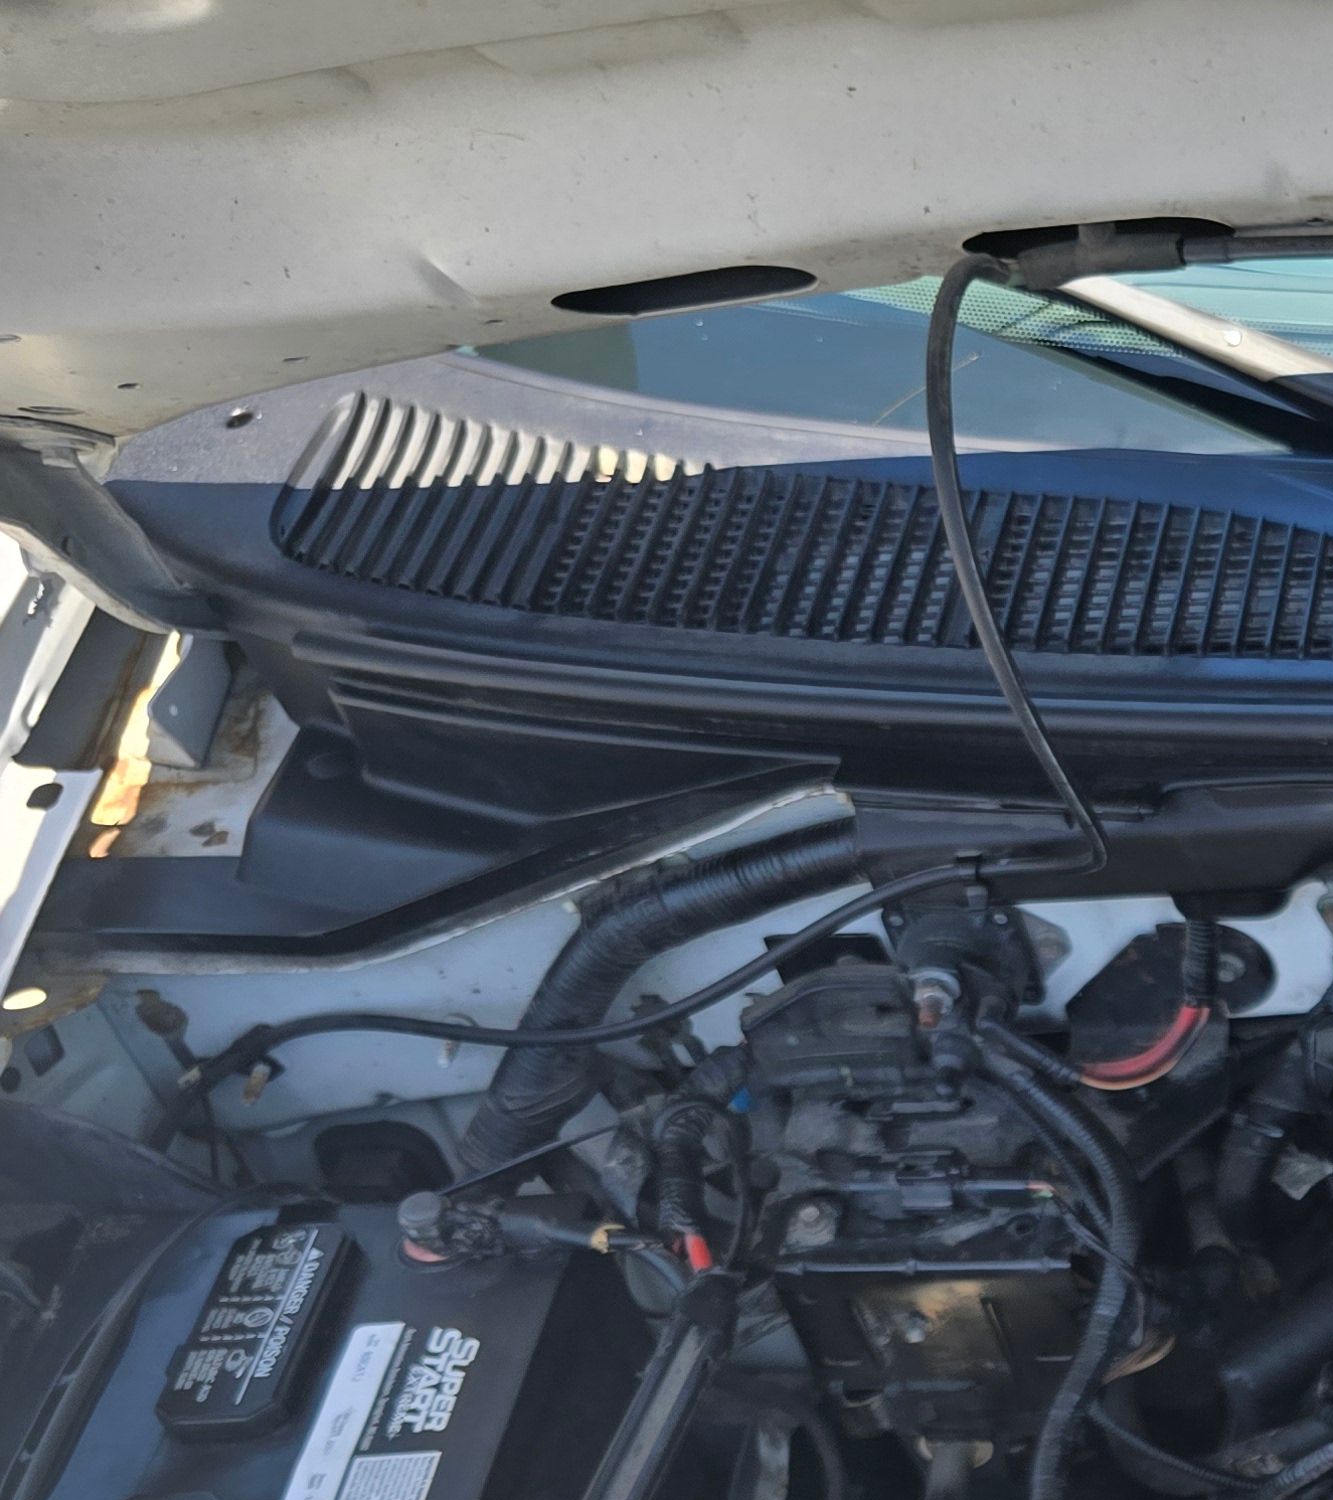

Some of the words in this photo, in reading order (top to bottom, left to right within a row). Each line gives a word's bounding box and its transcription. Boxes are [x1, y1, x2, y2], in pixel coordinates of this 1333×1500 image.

[284, 1262, 320, 1314] DANGER
[254, 1325, 291, 1378] POISON
[412, 1326, 462, 1433] START
[424, 1337, 480, 1431] SUPER
